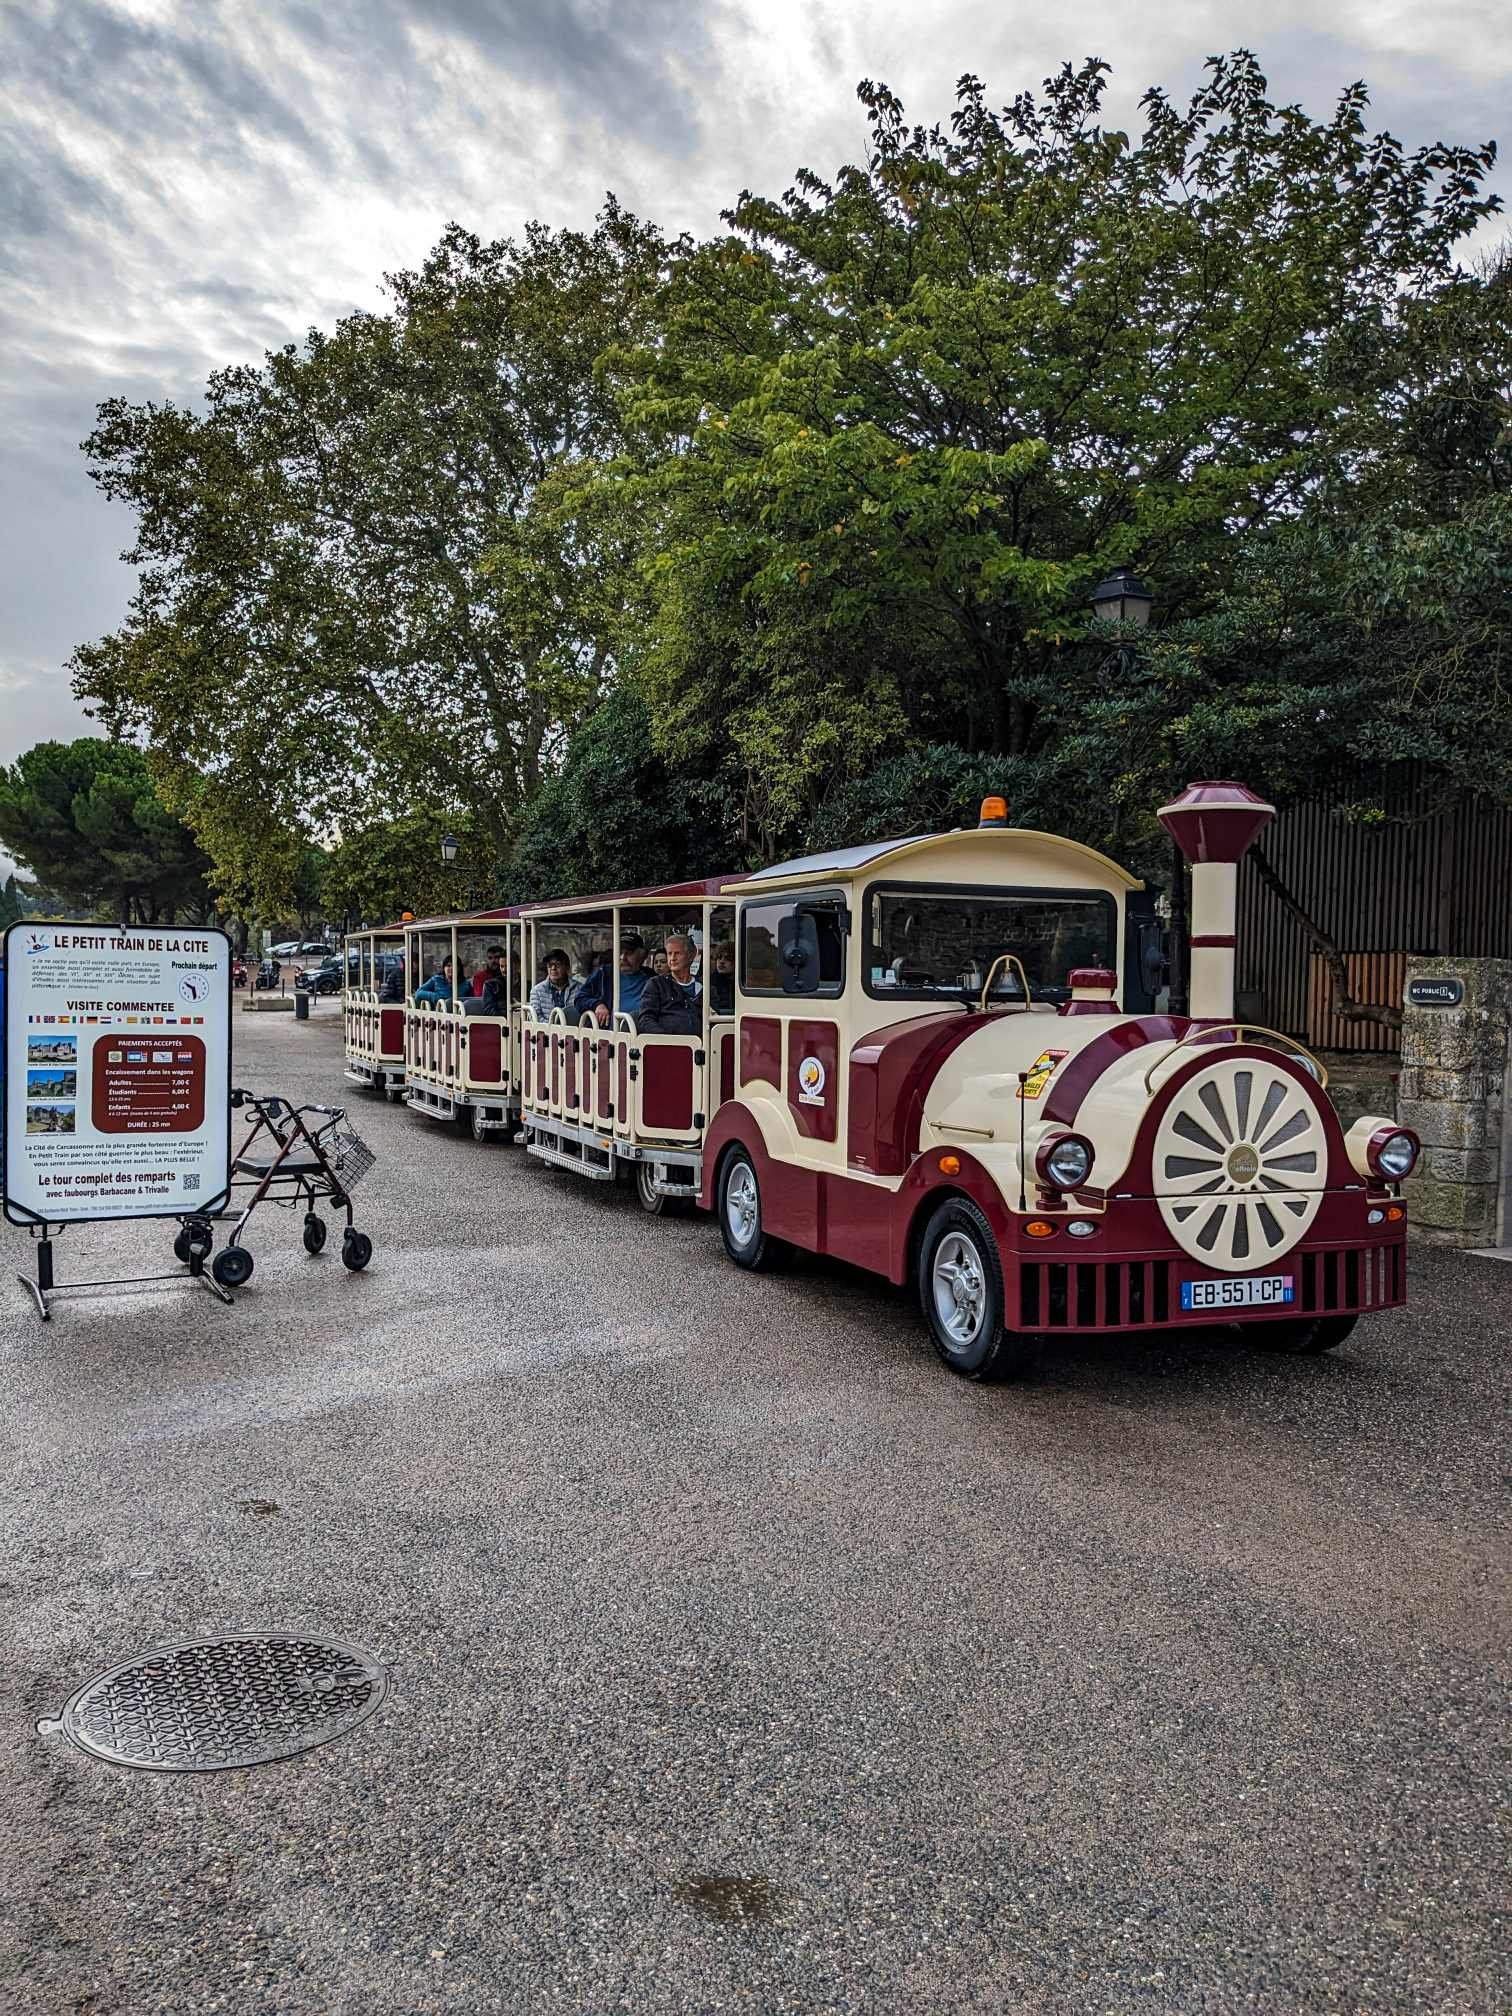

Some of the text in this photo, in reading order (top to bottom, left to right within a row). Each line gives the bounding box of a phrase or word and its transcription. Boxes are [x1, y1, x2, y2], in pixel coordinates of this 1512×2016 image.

[55, 936, 209, 953] LE PETIT TRAIN DE LA CITE
[171, 961, 218, 972] Prochain départ
[67, 1000, 175, 1012] VISITE COMMENTEE
[109, 1088, 137, 1096] Étudiants
[109, 1150, 133, 1158] guerrier
[38, 1171, 176, 1186] Le tour complet des remparts
[65, 1189, 98, 1199] faubourgs
[100, 1188, 136, 1196] Barbacane
[145, 1186, 170, 1194] Trivalle
[1193, 1280, 1283, 1306] EB-551-CP
